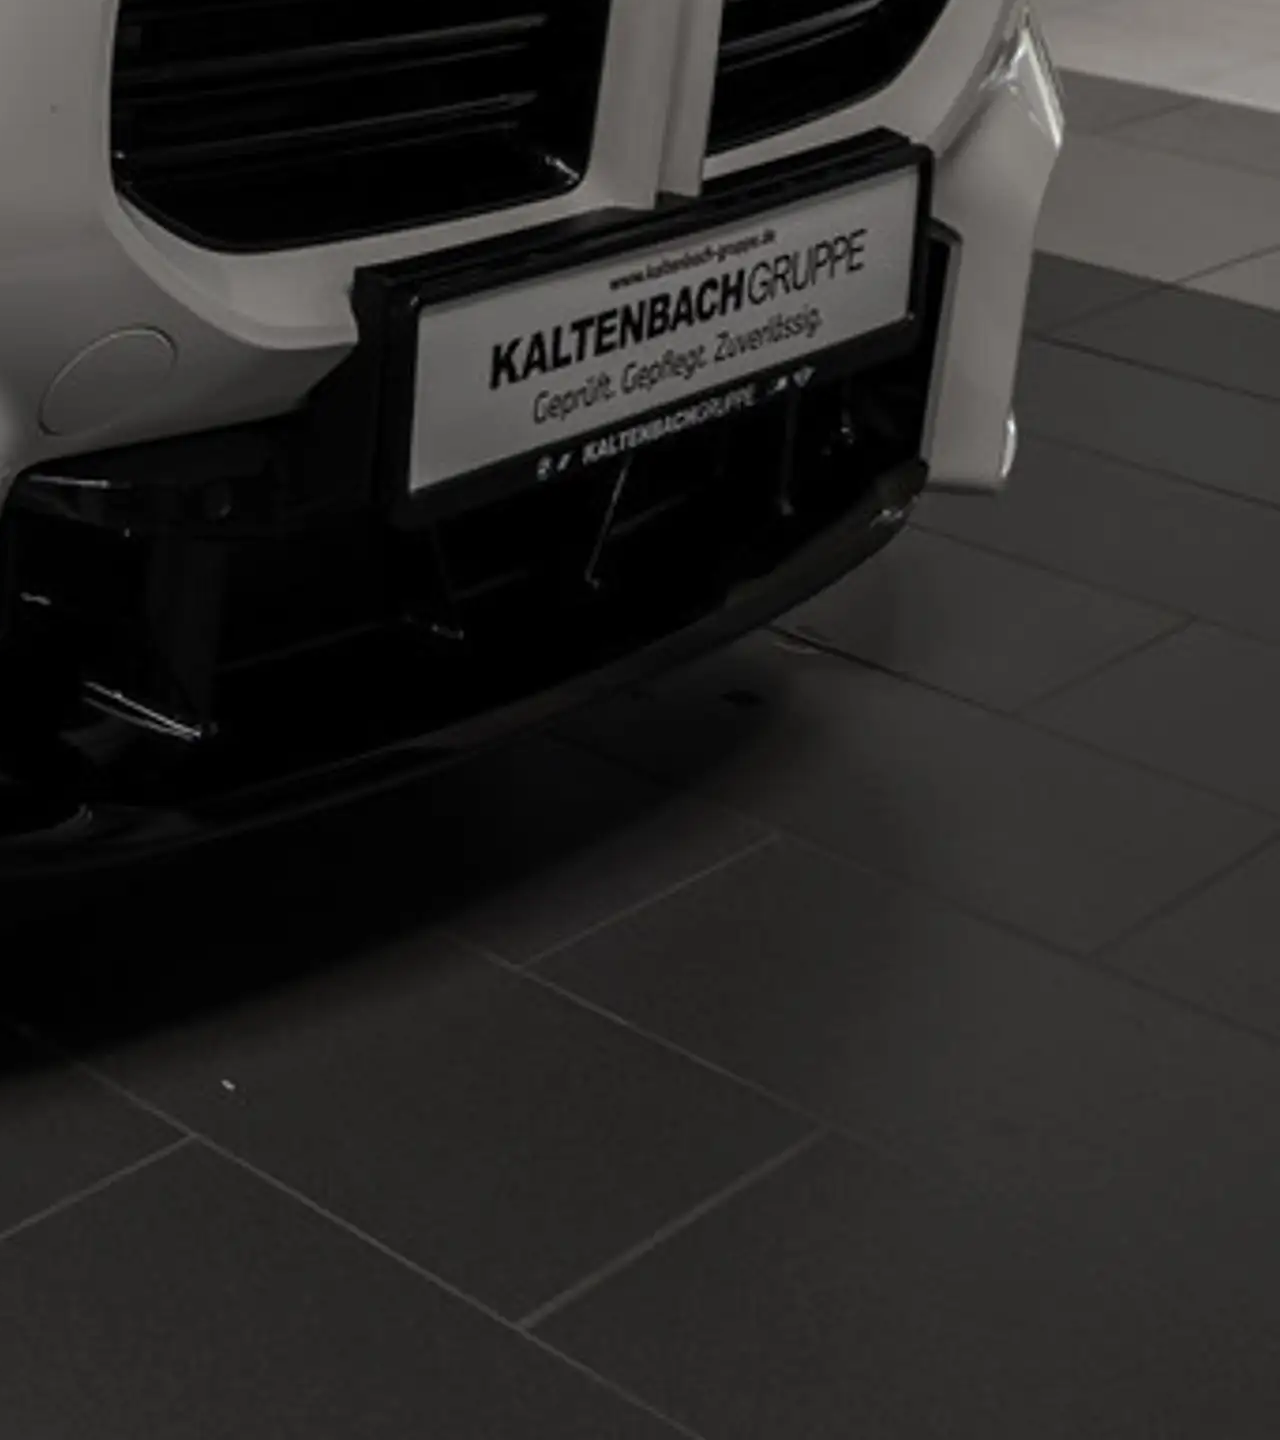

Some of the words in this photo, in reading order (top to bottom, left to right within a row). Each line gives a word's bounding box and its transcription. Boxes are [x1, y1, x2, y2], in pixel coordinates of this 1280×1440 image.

[489, 228, 868, 390] KALTENBACHGRUPPE
[532, 374, 616, 426] Geprüft.
[621, 344, 707, 395] Gepflegt.
[713, 306, 824, 363] Zuverlässig.
